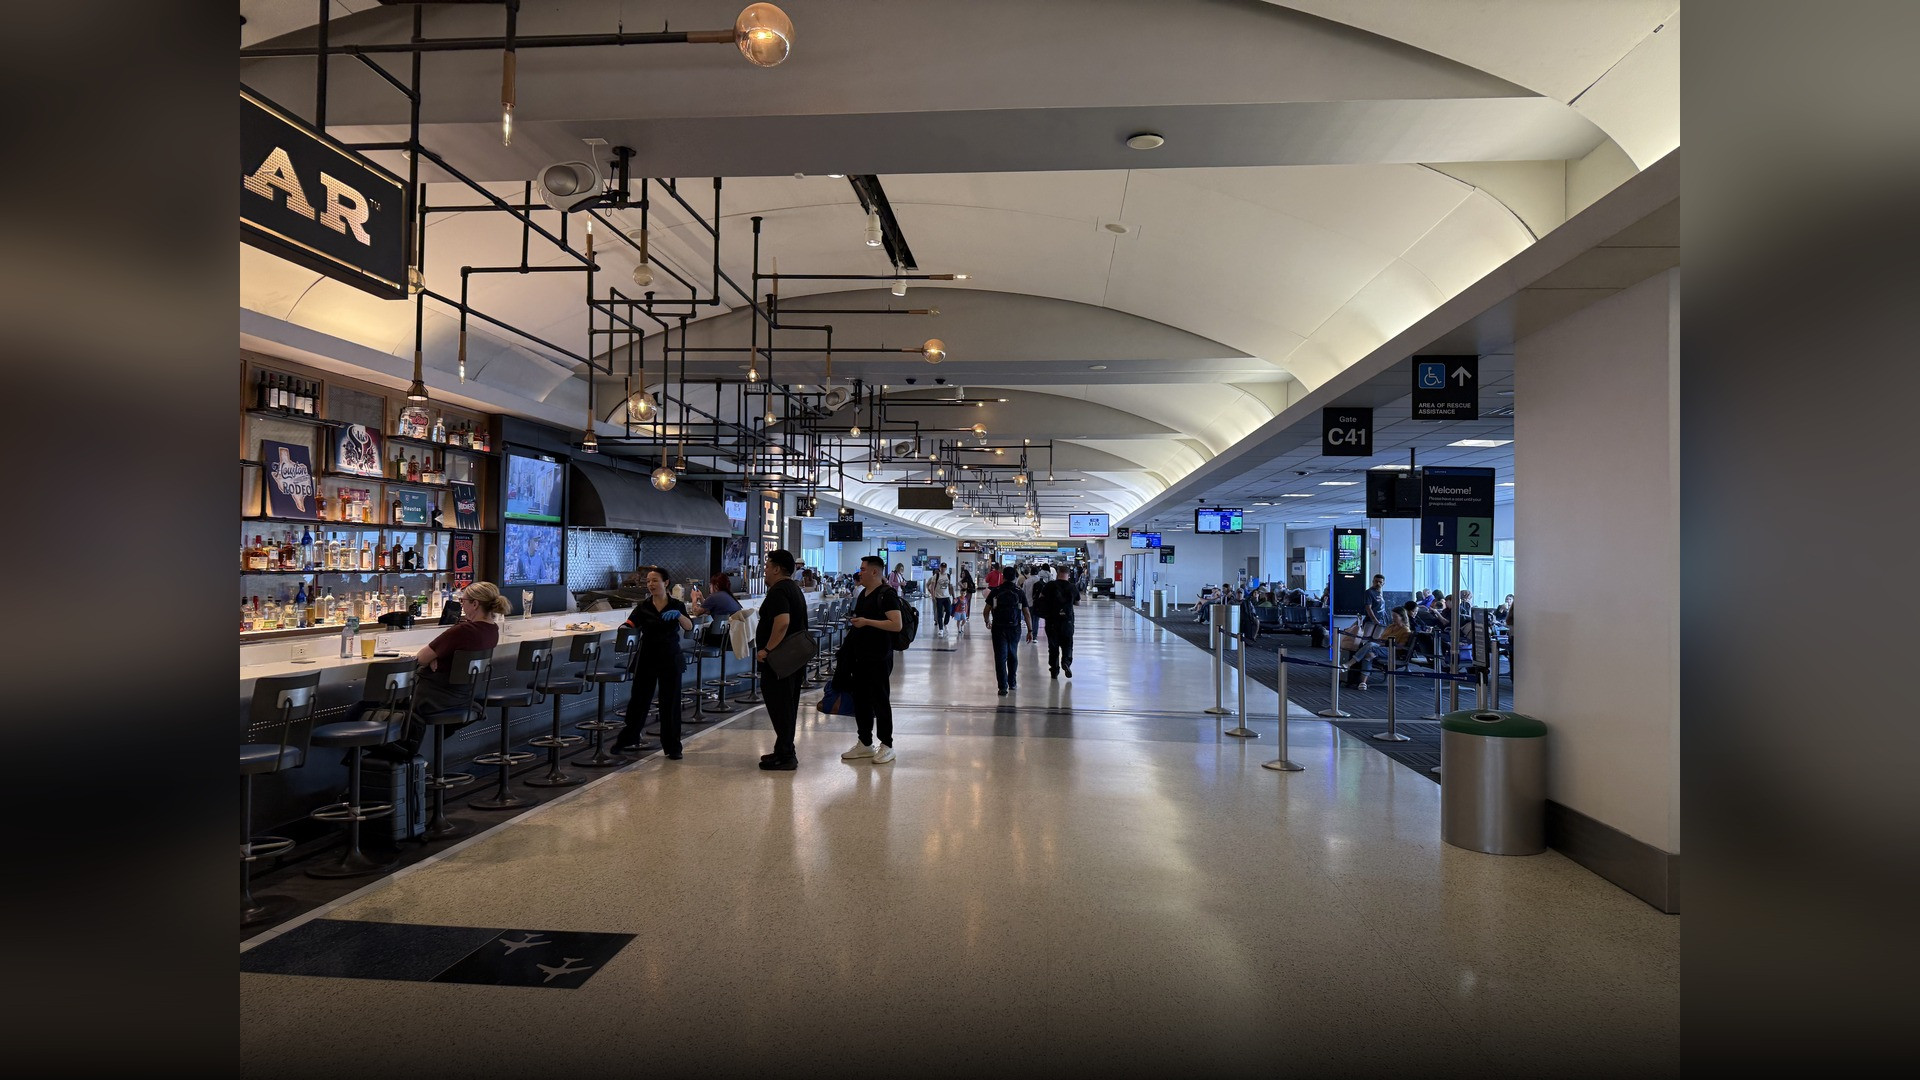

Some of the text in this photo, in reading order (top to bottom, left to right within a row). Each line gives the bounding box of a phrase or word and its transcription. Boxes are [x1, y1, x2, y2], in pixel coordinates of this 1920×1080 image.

[1327, 427, 1366, 446] C41
[283, 482, 312, 496] RODEO
[1429, 485, 1472, 495] Welcome!
[763, 500, 779, 533] H
[1437, 521, 1445, 536] 1
[1468, 522, 1480, 537] 2
[763, 540, 778, 552] BUR
